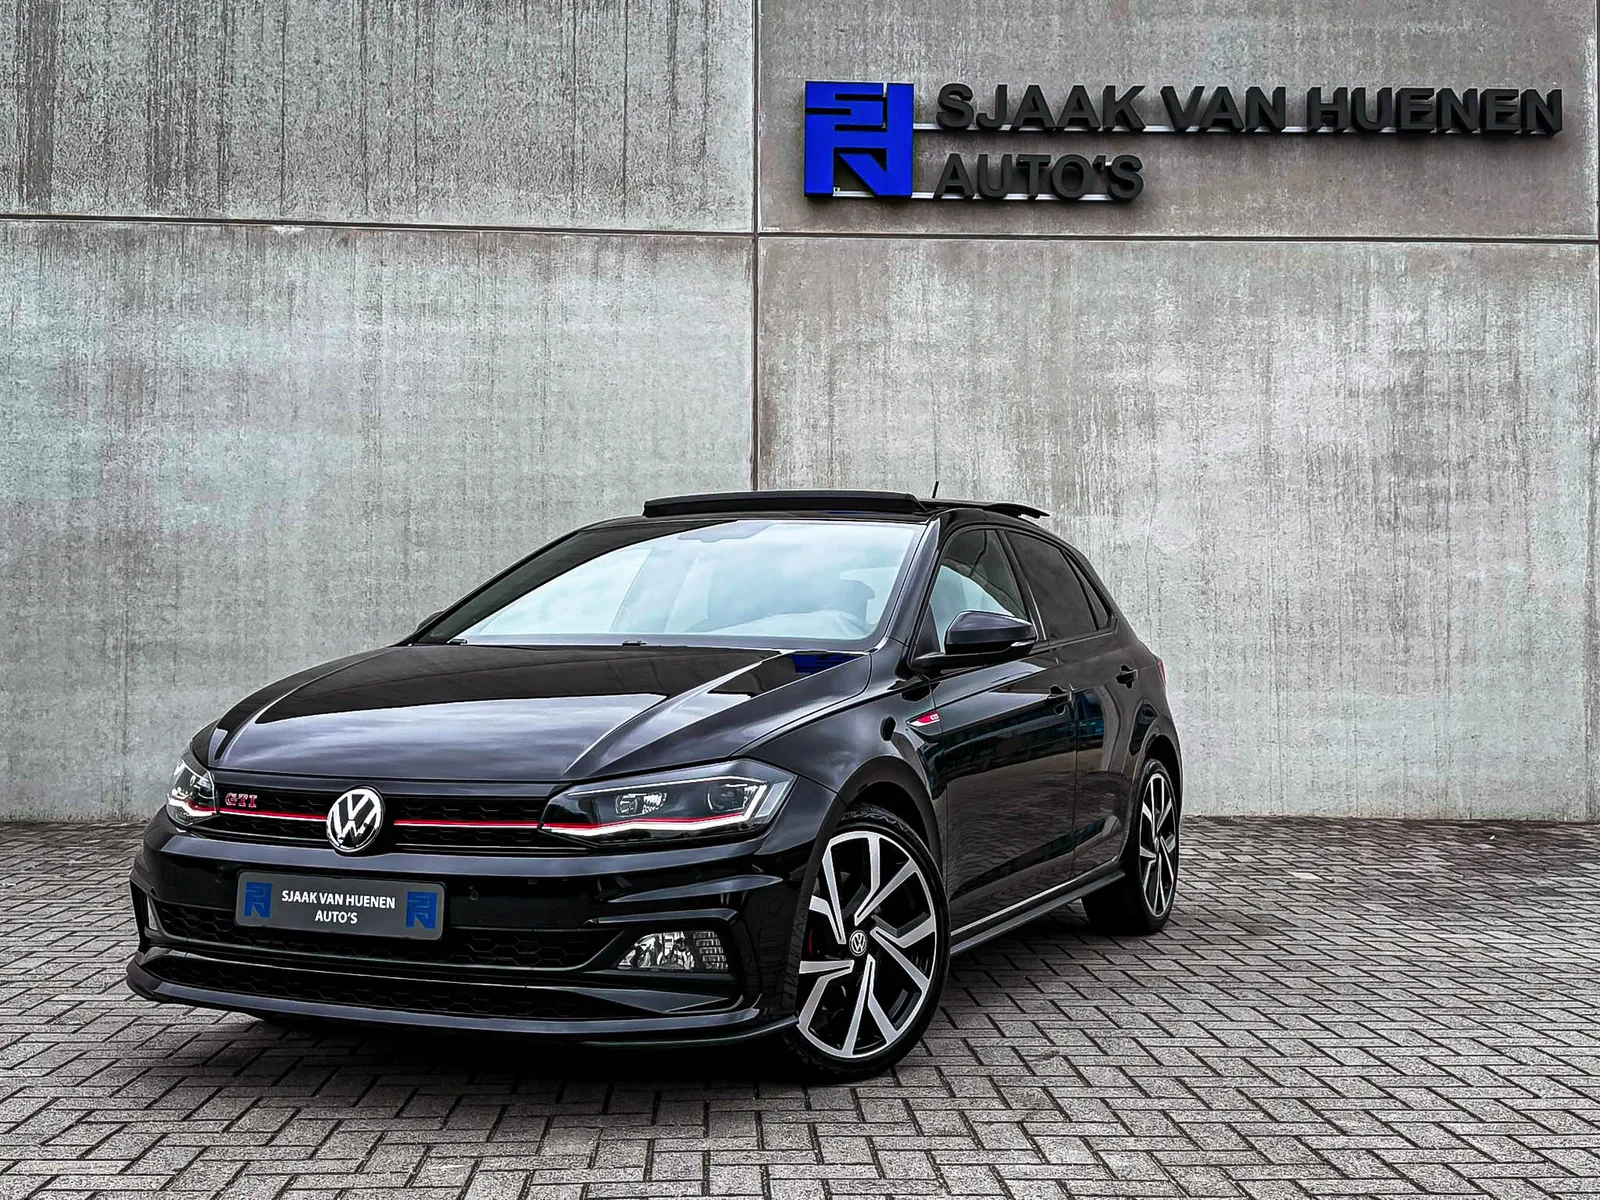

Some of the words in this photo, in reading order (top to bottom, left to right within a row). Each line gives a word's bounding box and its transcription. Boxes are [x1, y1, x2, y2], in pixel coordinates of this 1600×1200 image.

[936, 82, 1146, 131] SJAAK
[1159, 85, 1288, 133] VAN
[1305, 86, 1563, 137] HUENEN
[934, 153, 1144, 199] AUTO'S
[225, 793, 257, 808] GTI
[281, 889, 317, 904] SJAAK
[318, 892, 344, 906] VAN
[345, 893, 396, 910] HUENEN
[314, 909, 358, 924] AUTO'S
